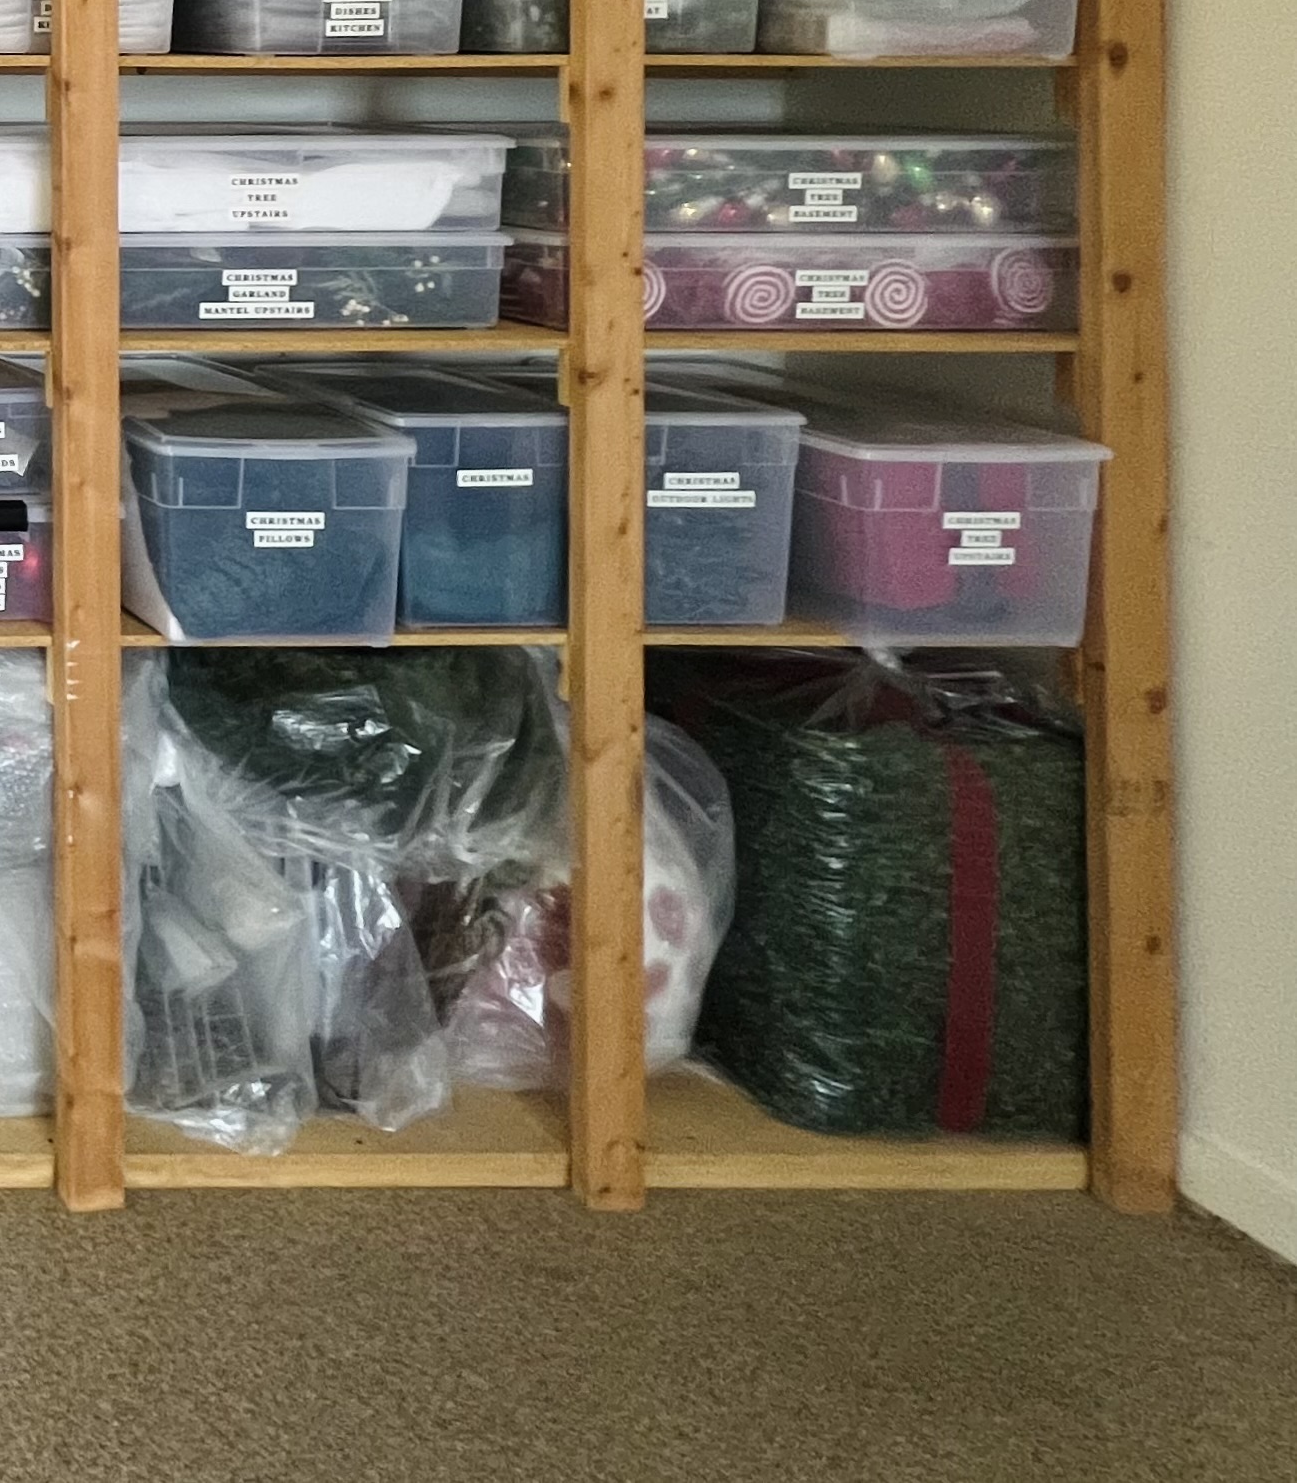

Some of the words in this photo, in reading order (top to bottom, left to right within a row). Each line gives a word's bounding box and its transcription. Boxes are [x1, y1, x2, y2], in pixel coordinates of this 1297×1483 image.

[335, 7, 377, 16] DISHES
[330, 24, 381, 33] KITCHEN
[231, 177, 299, 186] CHRISTMAS
[247, 193, 277, 202] TREE
[232, 210, 288, 218] UPSTAIRS
[226, 274, 294, 282] CHRISTMAS
[232, 290, 287, 298] GARLAND
[204, 306, 250, 315] MANTEL
[254, 306, 310, 315] UPSTAIRS
[461, 474, 529, 483] CHRISTMAS
[250, 517, 321, 525] CHRISTMAS
[258, 535, 311, 543] PILLOWS
